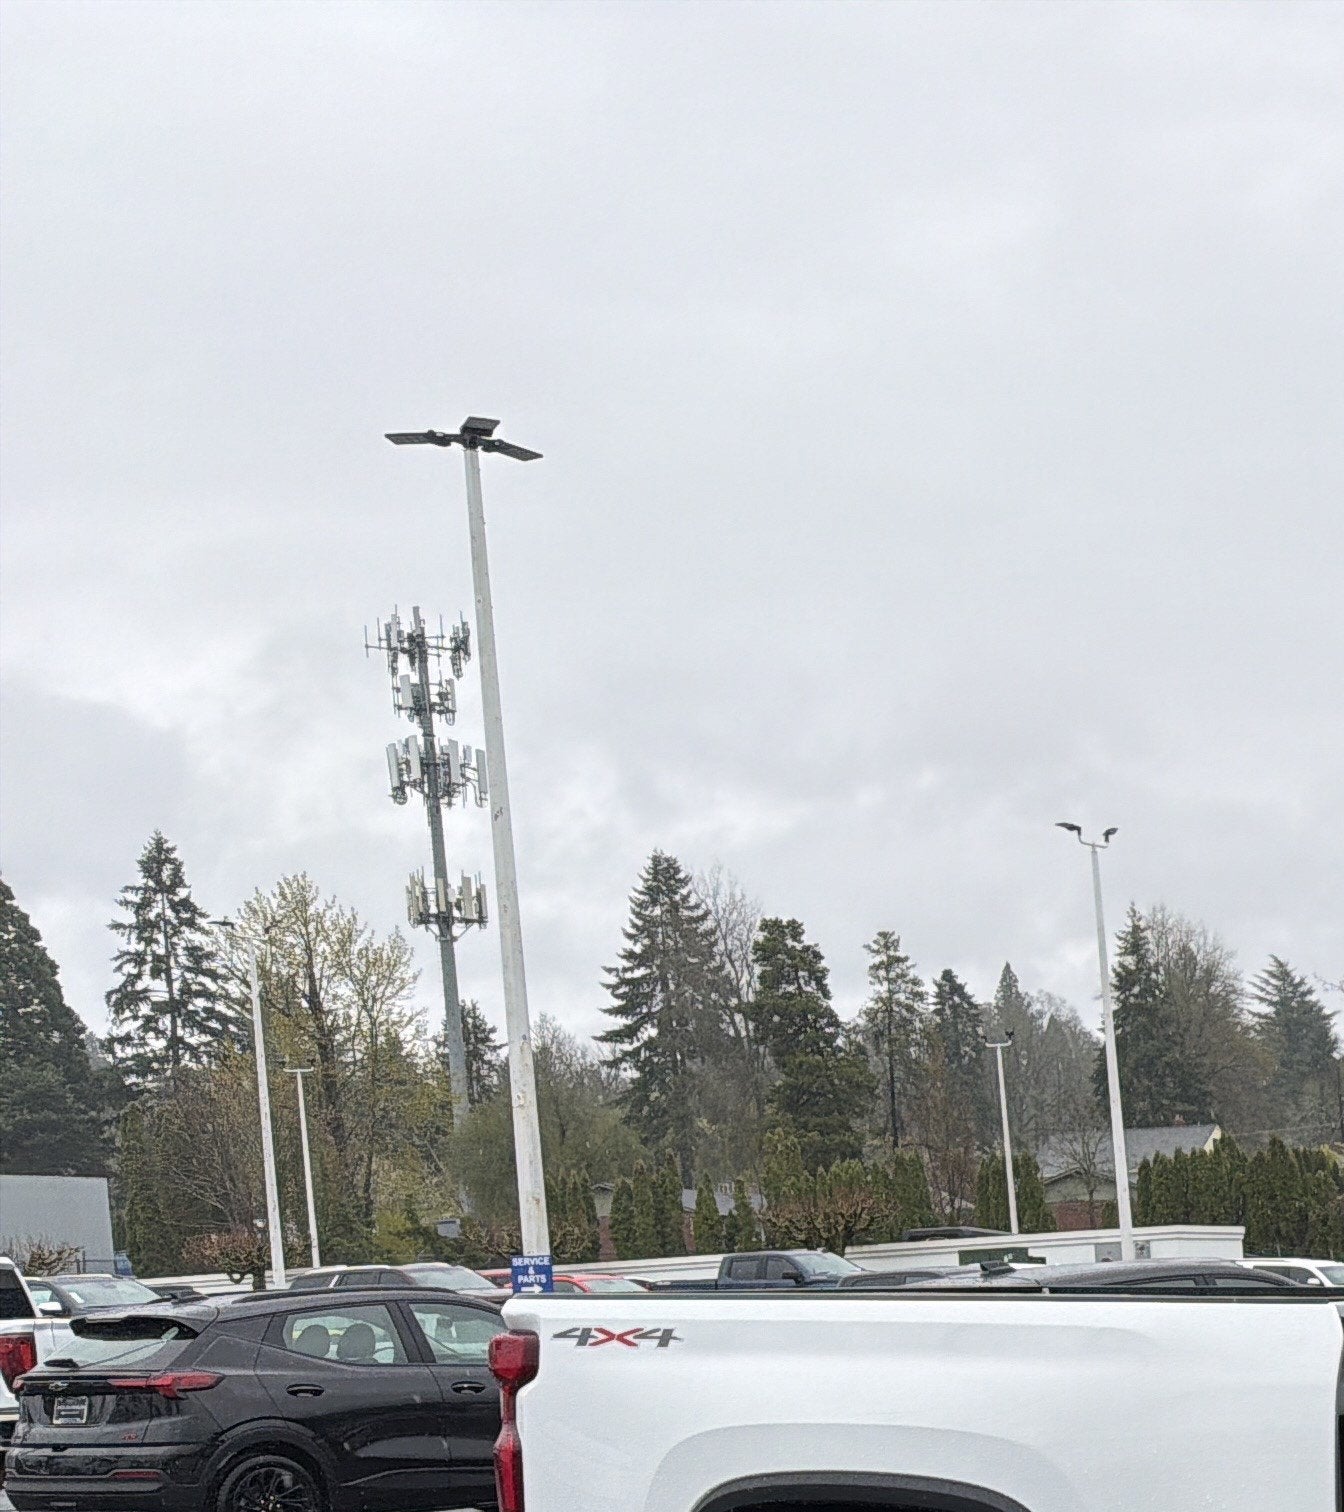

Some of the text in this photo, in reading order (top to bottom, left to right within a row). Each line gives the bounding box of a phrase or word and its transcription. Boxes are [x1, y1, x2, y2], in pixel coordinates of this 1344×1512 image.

[512, 1256, 550, 1266] SERVICE
[528, 1266, 535, 1275] &
[517, 1274, 547, 1284] PARTS
